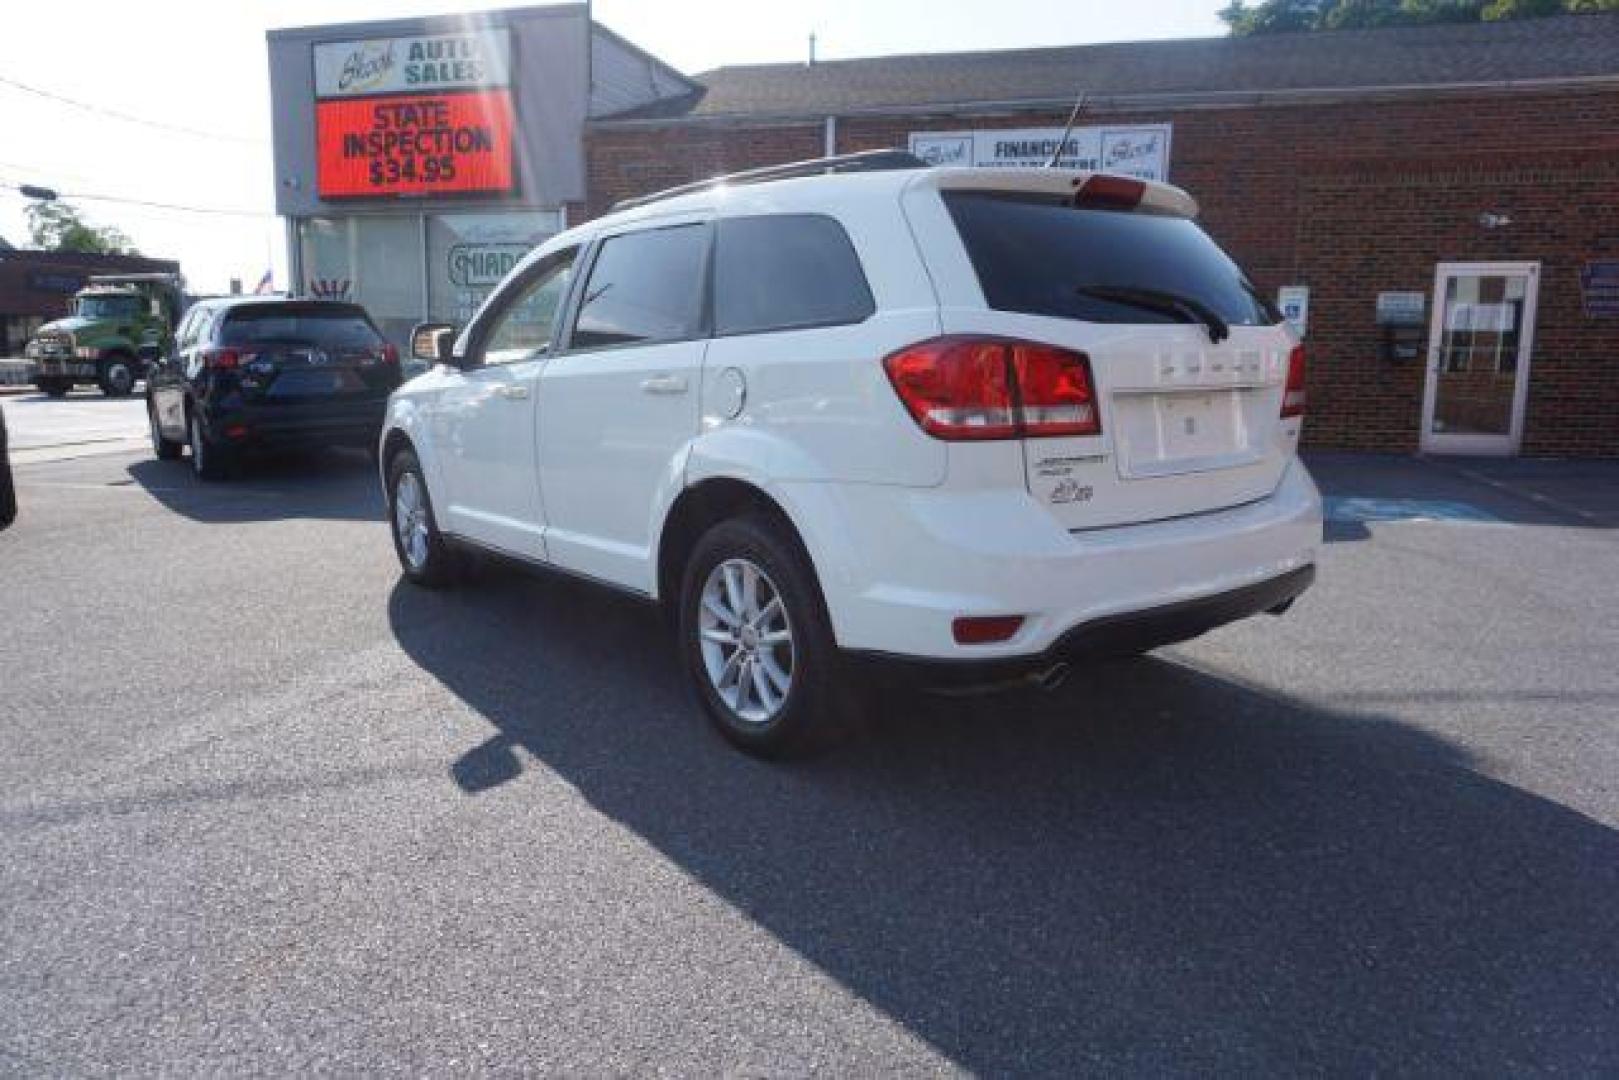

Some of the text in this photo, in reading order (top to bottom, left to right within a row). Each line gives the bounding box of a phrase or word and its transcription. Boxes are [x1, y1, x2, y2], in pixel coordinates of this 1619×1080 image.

[404, 60, 484, 84] SALES
[374, 101, 448, 130] STATE
[343, 126, 491, 159] INSPECTION
[369, 156, 455, 185] $34.95
